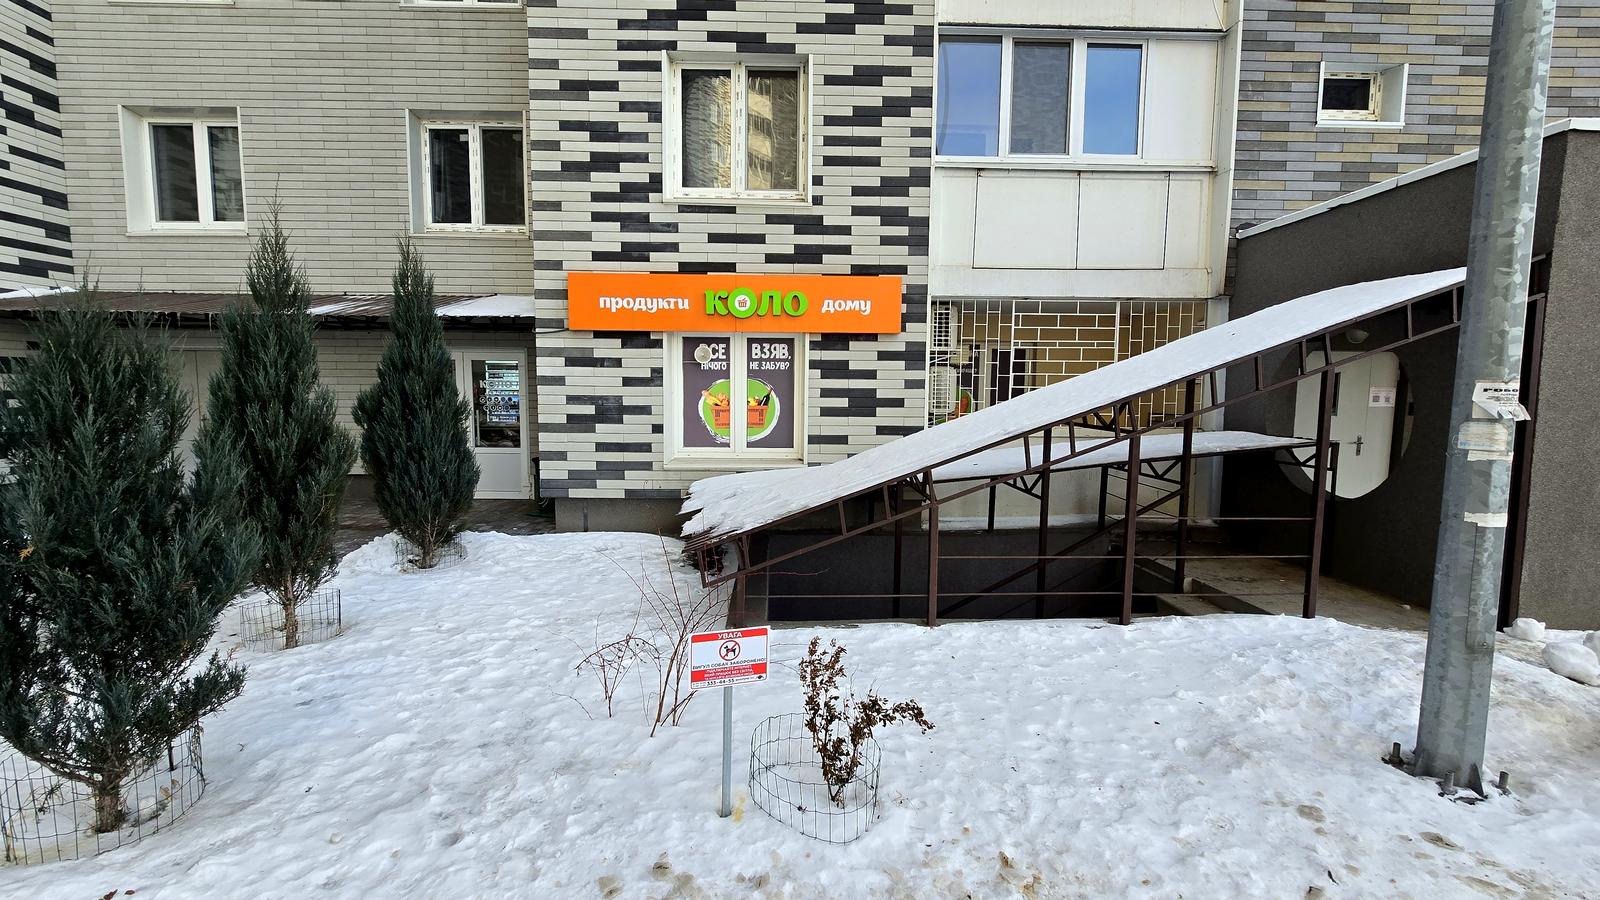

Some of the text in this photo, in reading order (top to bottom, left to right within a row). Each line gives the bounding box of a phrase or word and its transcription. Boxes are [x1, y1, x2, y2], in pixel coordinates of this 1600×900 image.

[599, 296, 689, 313] продукти
[821, 298, 872, 316] дому
[699, 343, 792, 360] СЕ ВЗЯВ,
[700, 361, 790, 370] НІЧОГО НЕ ЗАБУВ?
[717, 631, 743, 640] УВАГА
